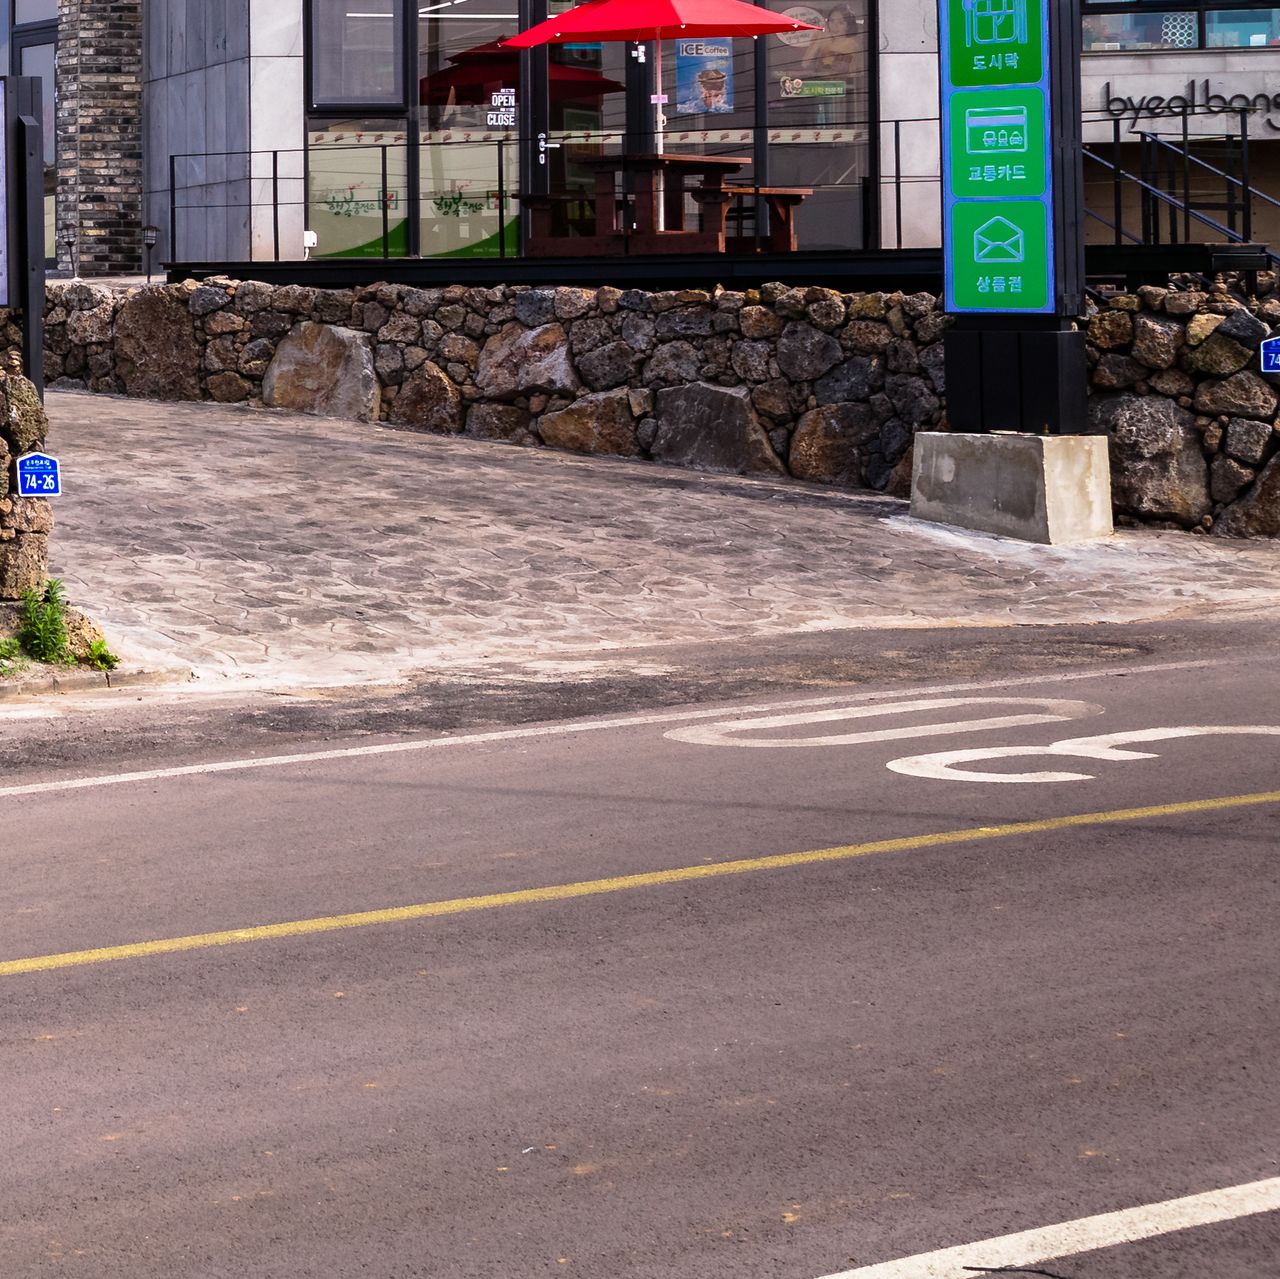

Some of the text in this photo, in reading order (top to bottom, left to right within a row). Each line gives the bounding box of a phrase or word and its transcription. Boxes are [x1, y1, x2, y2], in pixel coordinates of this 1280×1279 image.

[680, 43, 729, 56] ICE Coffee
[972, 52, 1020, 71] 도시락
[491, 94, 516, 107] OPEN
[487, 113, 516, 126] CLOSE
[967, 164, 1028, 182] 교통카드
[975, 275, 1023, 294] 상품권
[24, 473, 56, 490] 74-26
